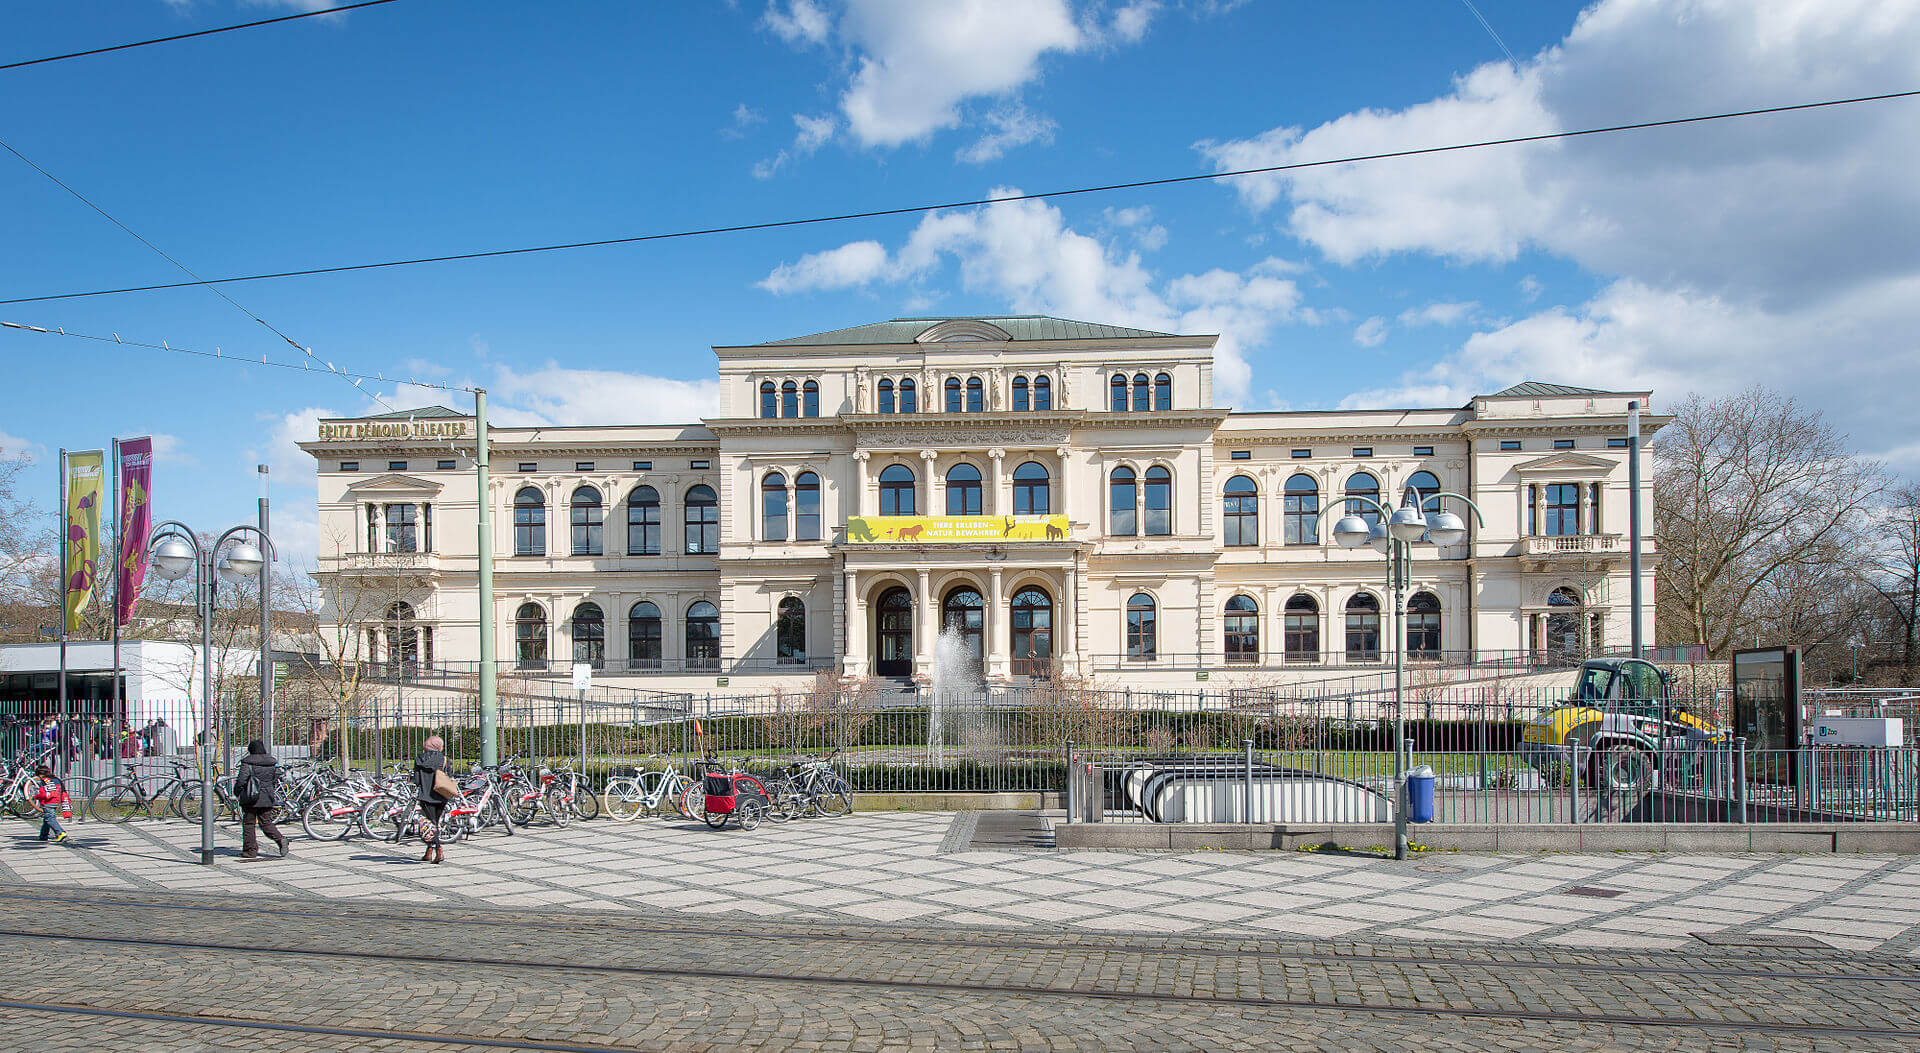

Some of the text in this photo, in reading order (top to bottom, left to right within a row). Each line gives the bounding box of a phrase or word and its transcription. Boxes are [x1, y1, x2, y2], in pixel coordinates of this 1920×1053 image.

[318, 422, 467, 438] FRITZ RÉMOND THEATER
[932, 521, 953, 529] TIERE
[926, 529, 1001, 537] NATUR BEWAHREN
[1827, 728, 1838, 736] Zoo
